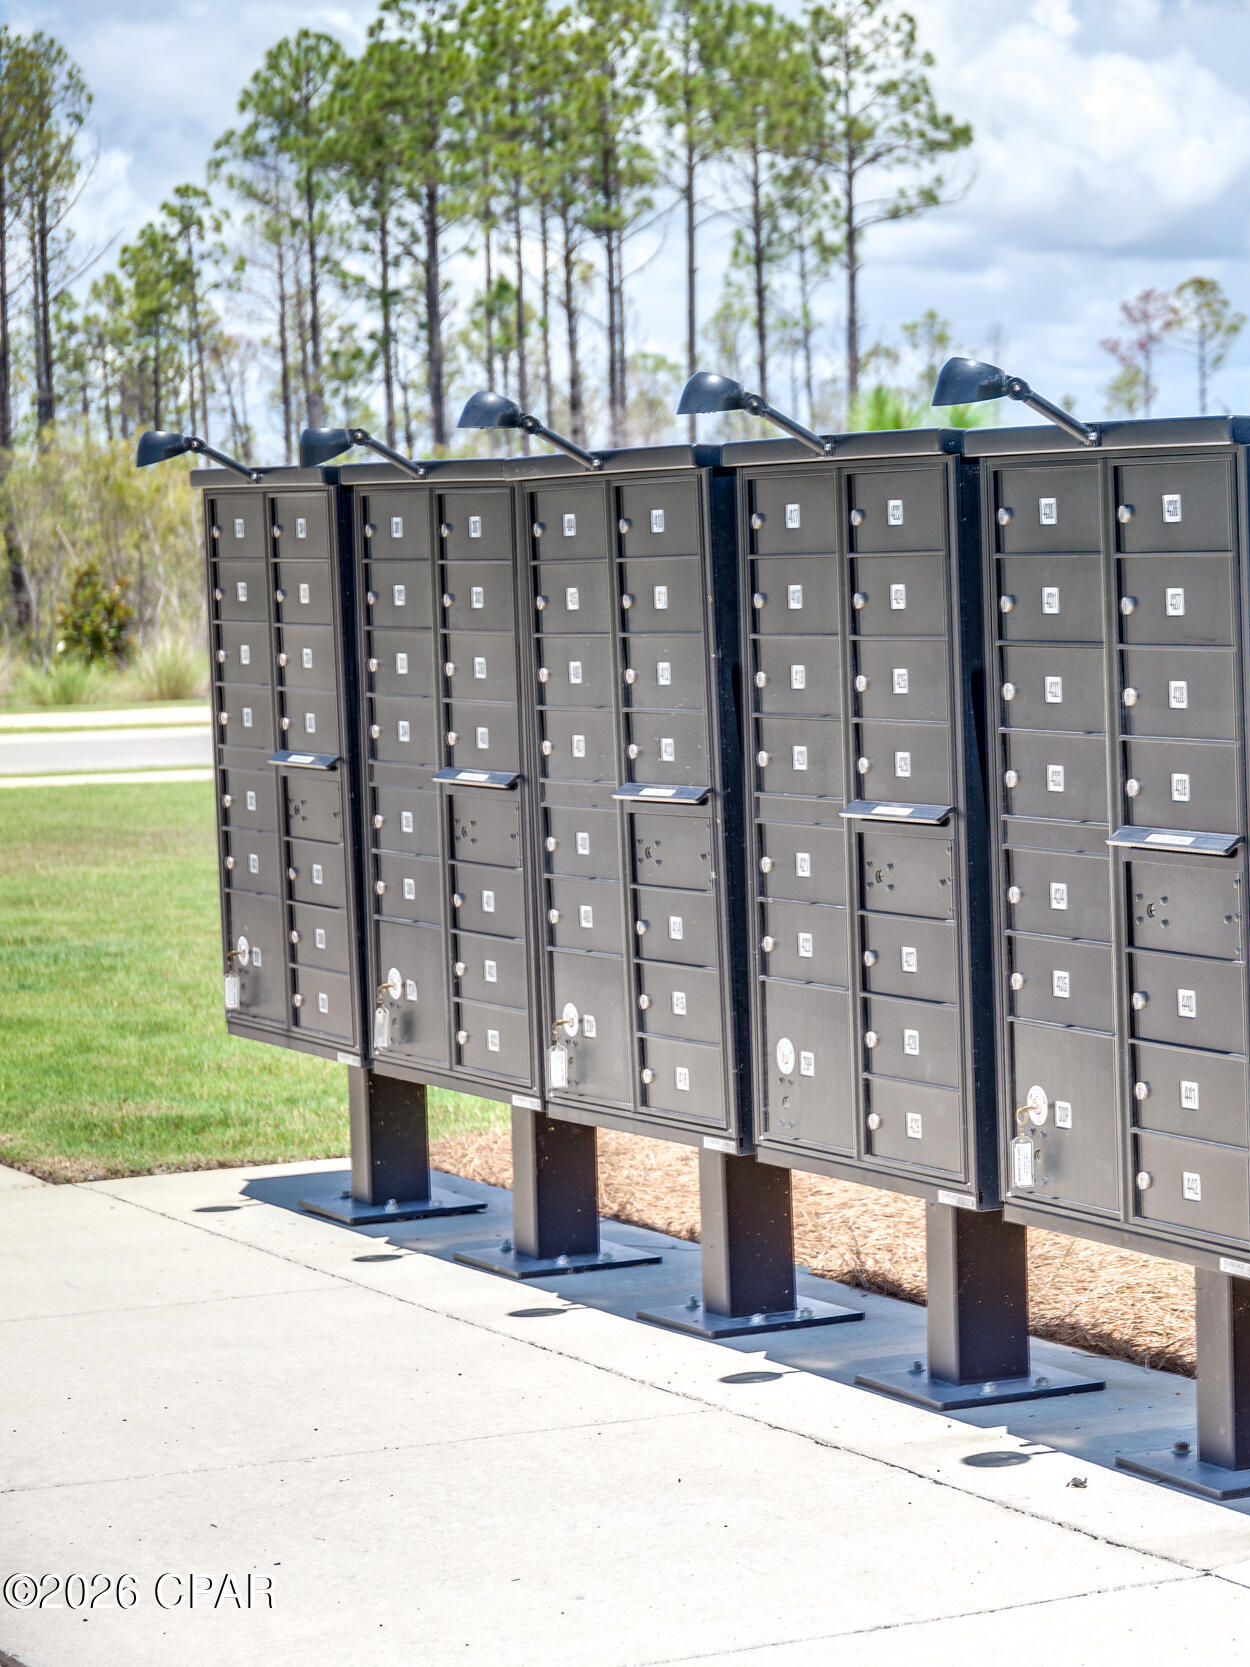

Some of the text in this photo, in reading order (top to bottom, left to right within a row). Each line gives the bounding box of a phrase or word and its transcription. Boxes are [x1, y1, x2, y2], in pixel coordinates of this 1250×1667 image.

[1181, 995, 1194, 1013] 440
[1184, 1086, 1196, 1104] 441
[1186, 1177, 1199, 1196] 442
